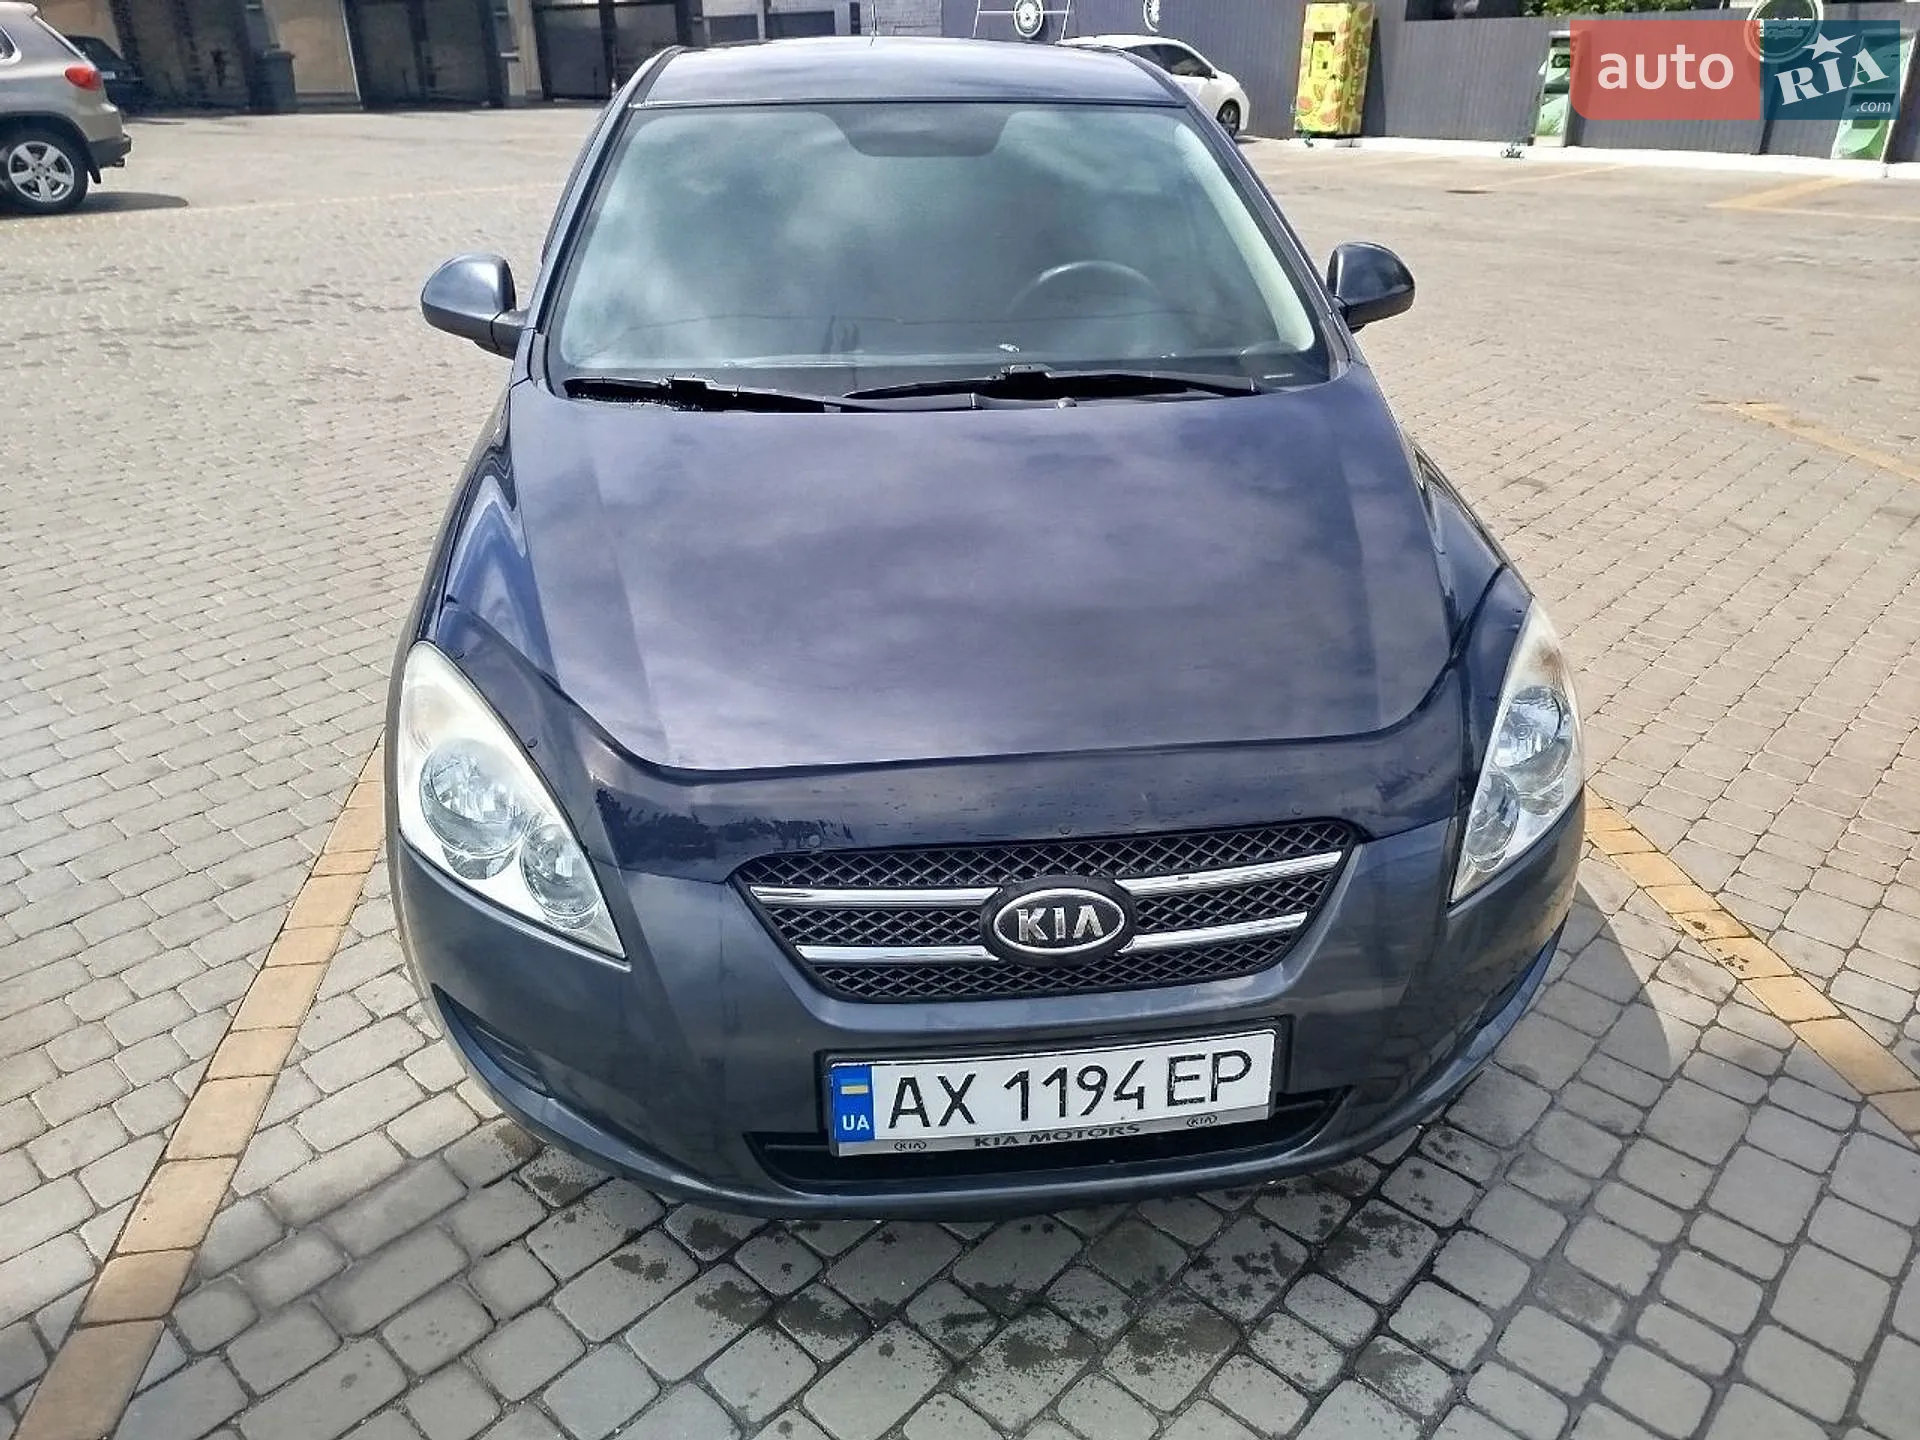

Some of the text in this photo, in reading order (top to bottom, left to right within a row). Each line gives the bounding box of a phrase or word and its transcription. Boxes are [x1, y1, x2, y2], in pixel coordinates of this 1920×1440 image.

[1016, 904, 1104, 942] KIA
[889, 1049, 1253, 1129] AX 1194 EP
[843, 1115, 870, 1131] UA
[974, 1123, 1141, 1147] KIA MOTORS
[897, 1141, 923, 1150] KIA
